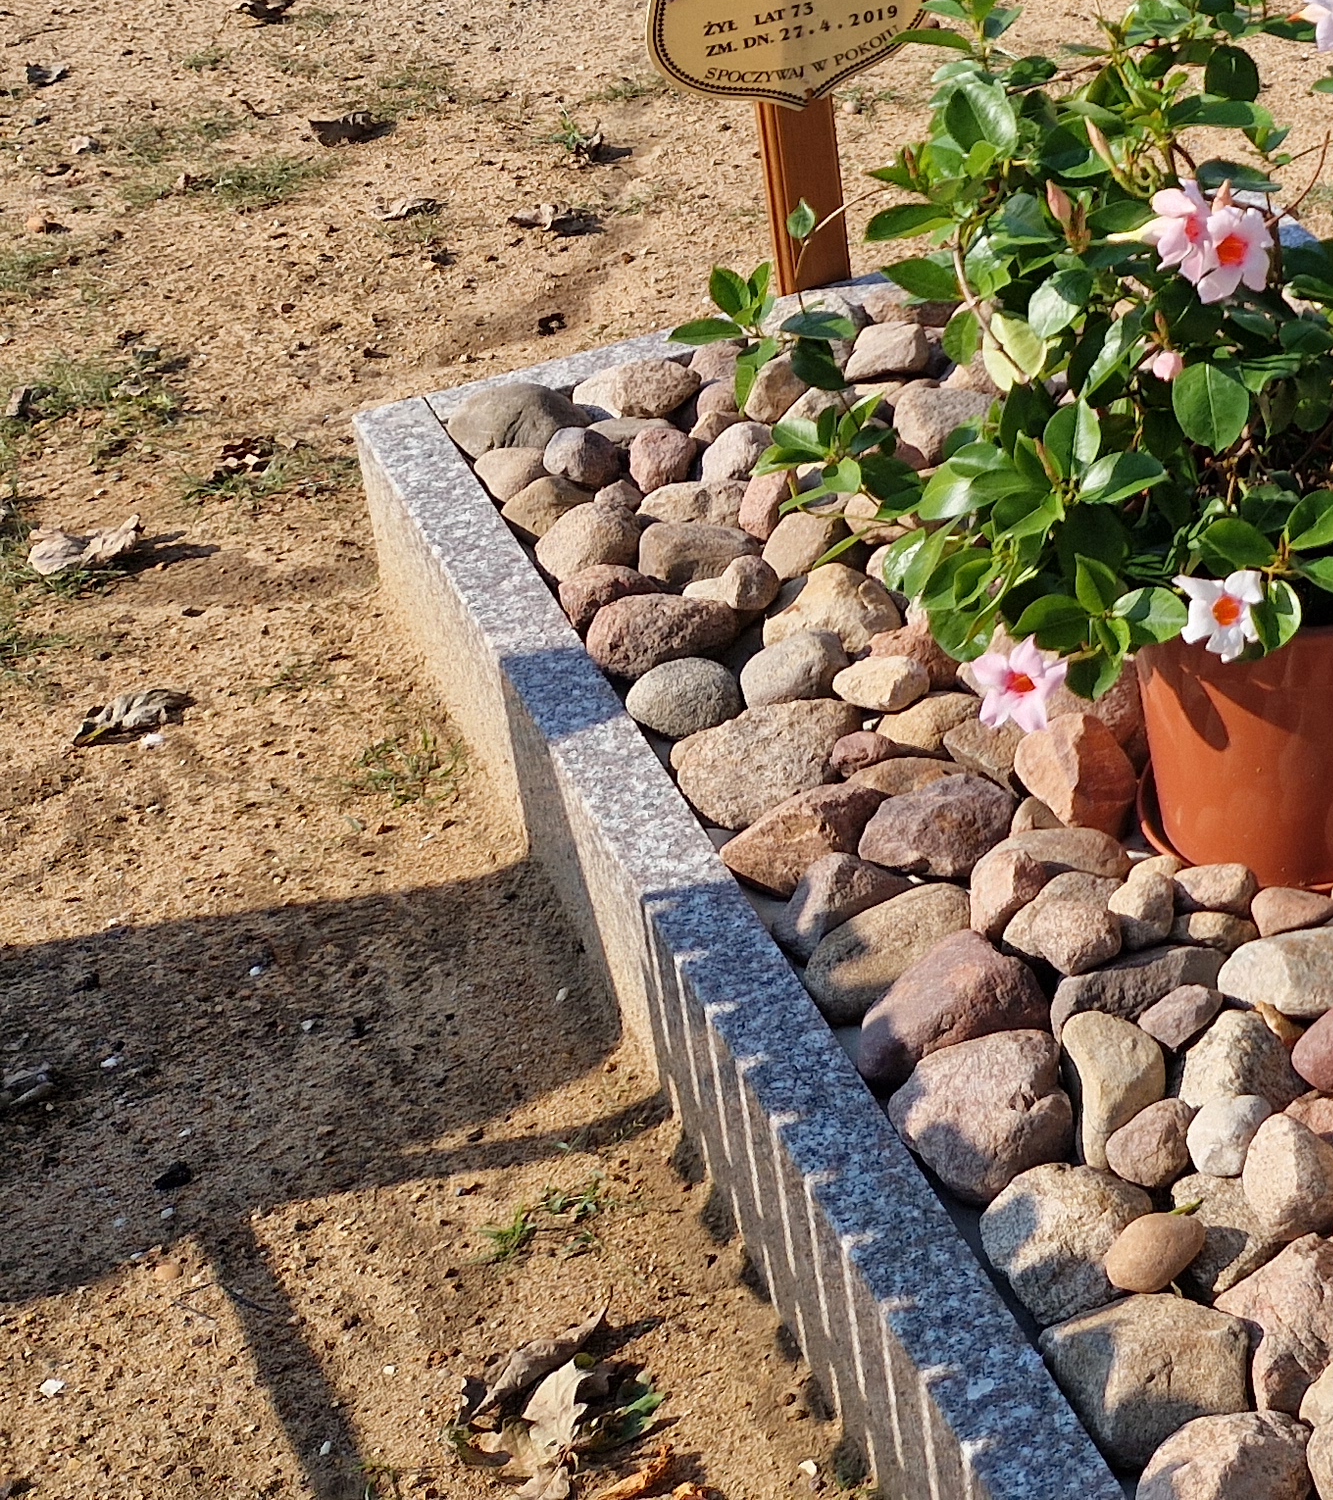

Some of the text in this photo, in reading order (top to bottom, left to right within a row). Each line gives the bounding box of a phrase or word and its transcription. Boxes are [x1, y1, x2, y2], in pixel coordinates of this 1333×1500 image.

[703, 1, 814, 37] ŻYŁ LAT 73
[705, 41, 738, 58] ZM.
[743, 33, 775, 50] DN.
[704, 65, 804, 84] SPOCZYWAJ
[811, 58, 828, 73] W
